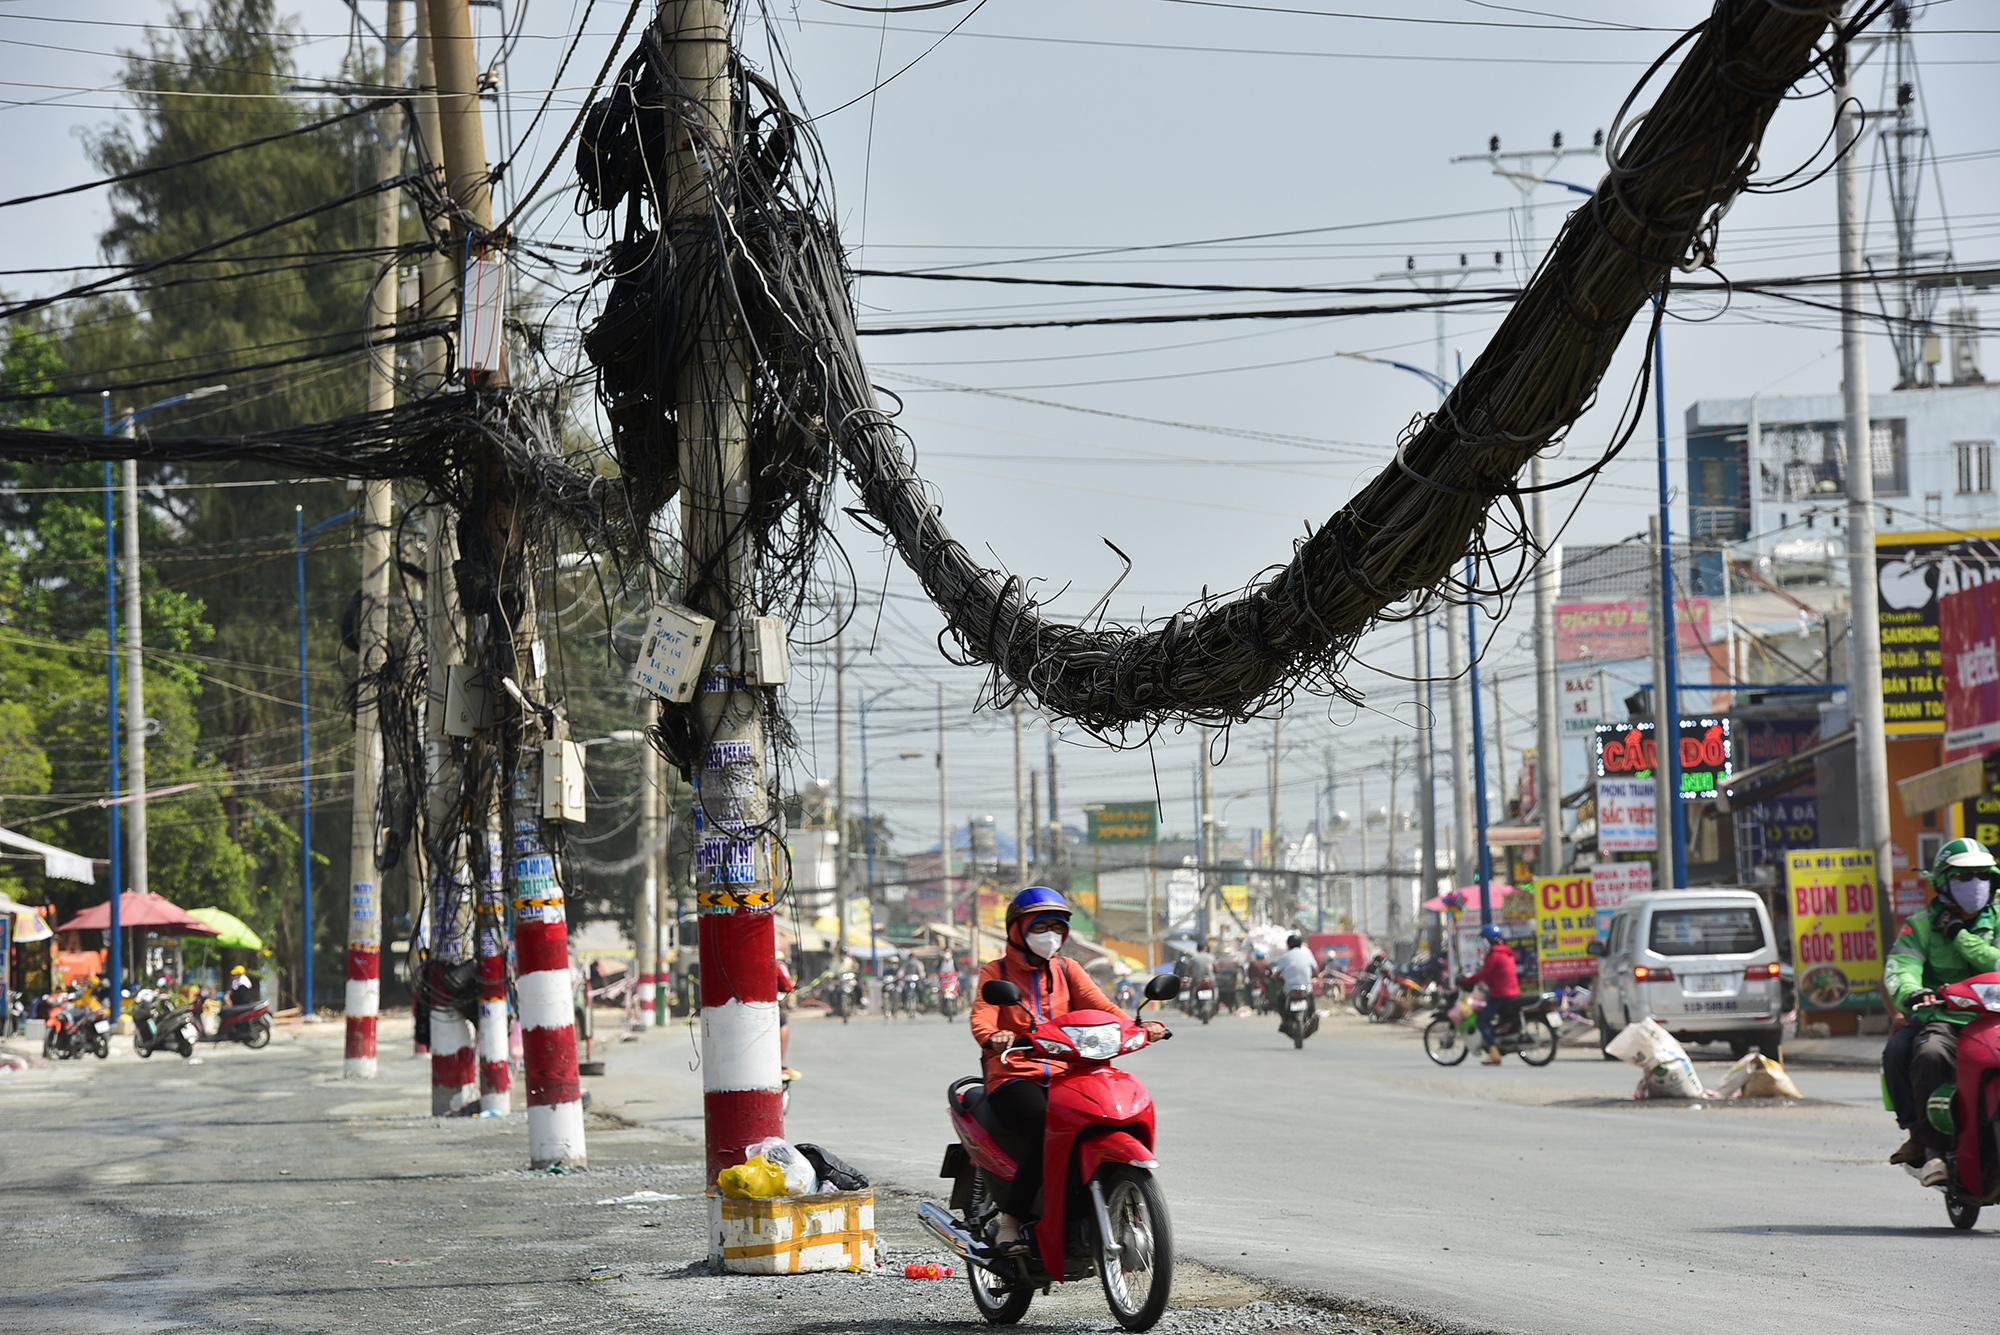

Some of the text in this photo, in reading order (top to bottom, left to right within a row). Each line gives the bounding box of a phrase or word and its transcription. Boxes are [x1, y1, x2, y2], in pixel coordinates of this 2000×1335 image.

[1881, 624, 1940, 644] SAMSUNG
[636, 670, 653, 685] 178
[662, 665, 677, 677] 33
[1795, 877, 1839, 917] BÚN
[1844, 874, 1875, 915] BÒ
[1800, 918, 1878, 964] GỐC HUẾ
